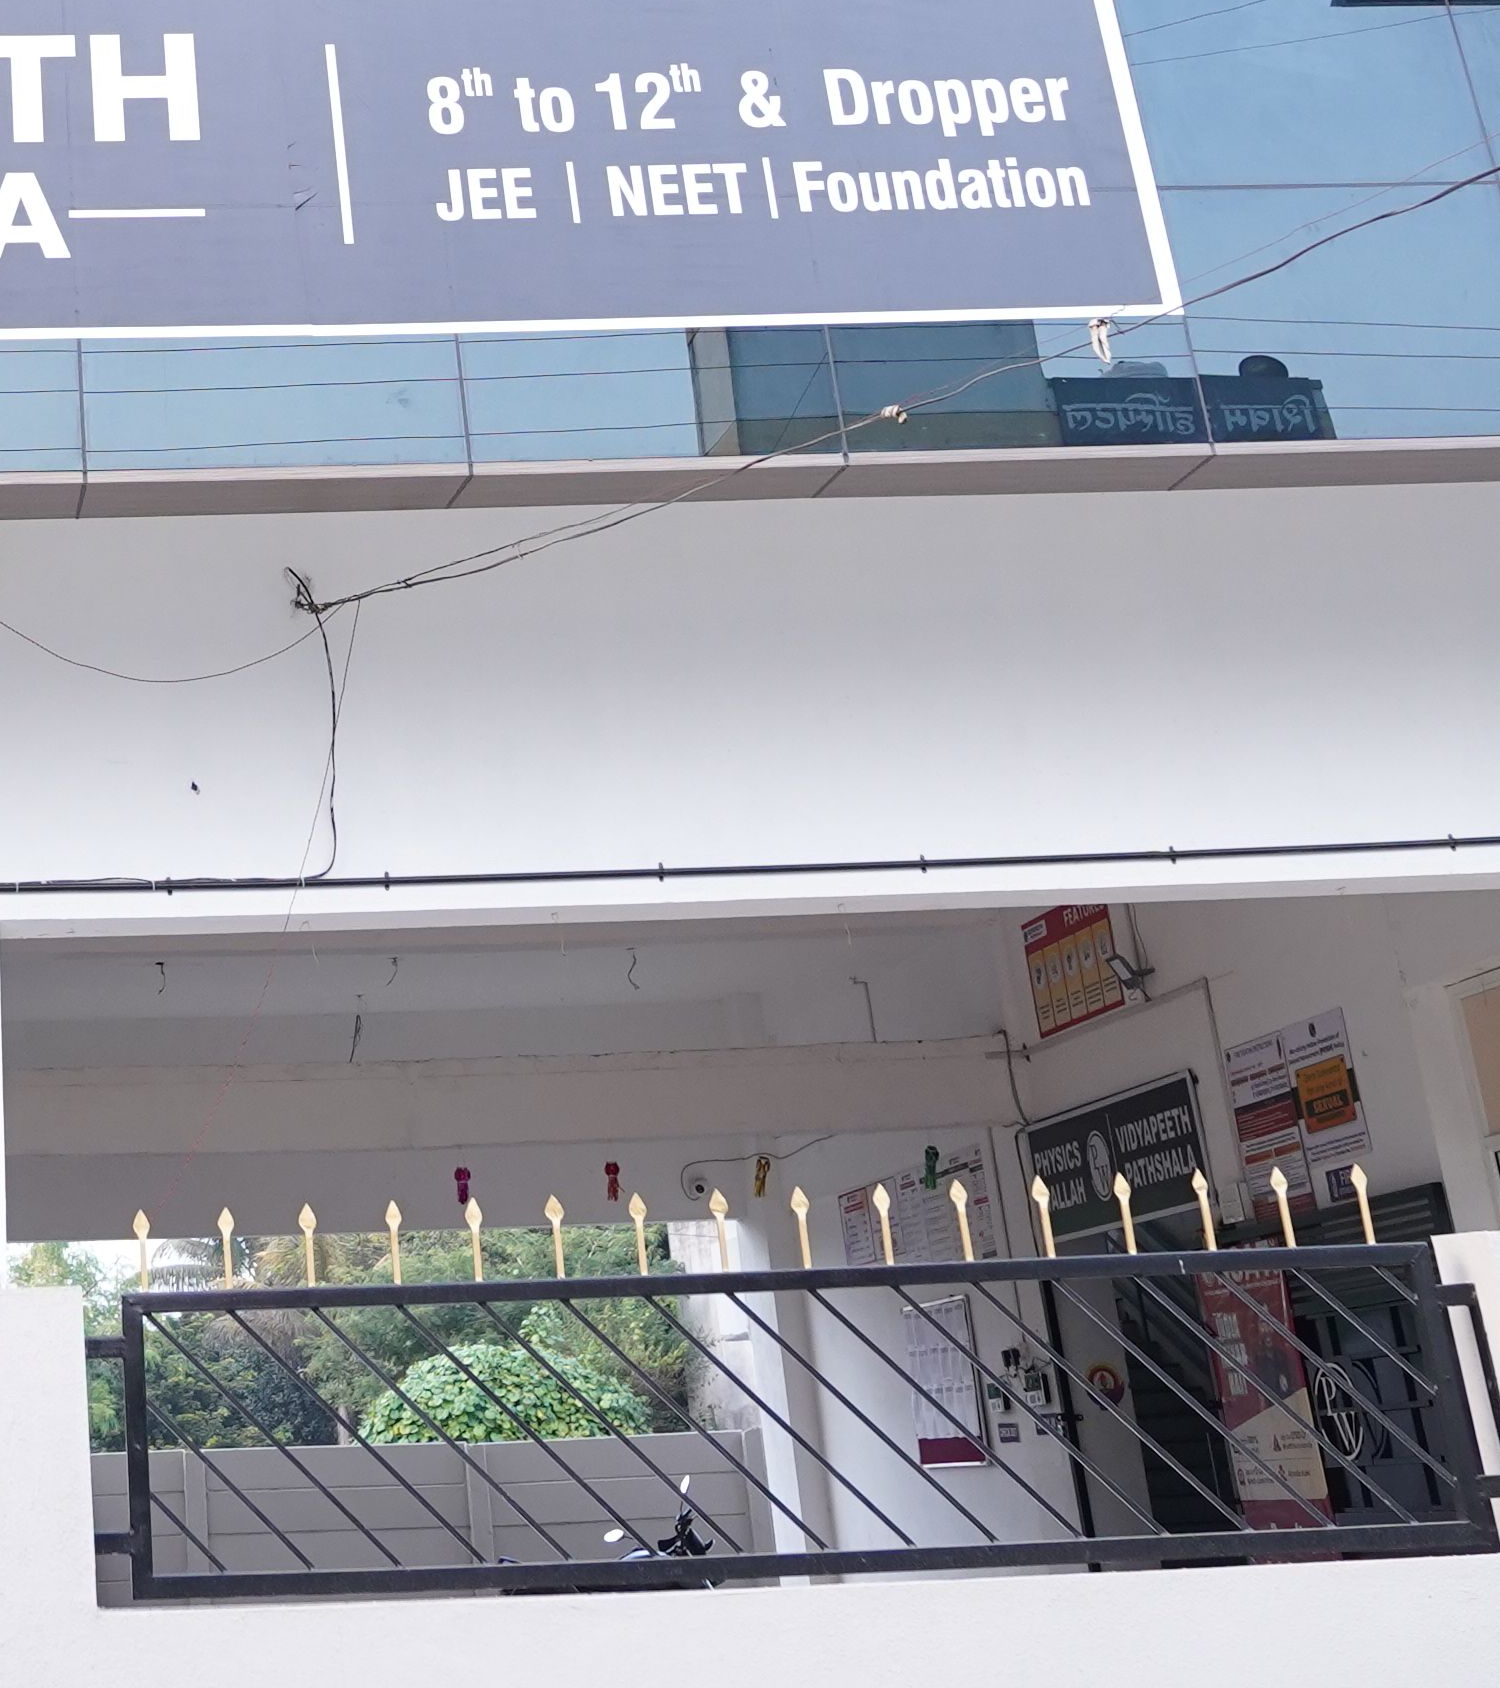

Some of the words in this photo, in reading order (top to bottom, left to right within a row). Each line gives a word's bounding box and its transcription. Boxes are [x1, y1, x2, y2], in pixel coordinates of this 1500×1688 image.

[427, 68, 492, 134] 8th
[514, 78, 574, 132] to
[595, 63, 701, 129] 12th
[739, 71, 786, 127] &
[824, 69, 1068, 136] Dropper
[437, 168, 536, 221] JEE
[607, 163, 746, 216] NEET
[793, 158, 1090, 212] Foundation
[1115, 1105, 1192, 1153] VIDYAPEETH
[1034, 1141, 1082, 1176] PHYSICS
[1124, 1144, 1197, 1189] PATHSHALA
[1050, 1176, 1087, 1211] ALLAH
